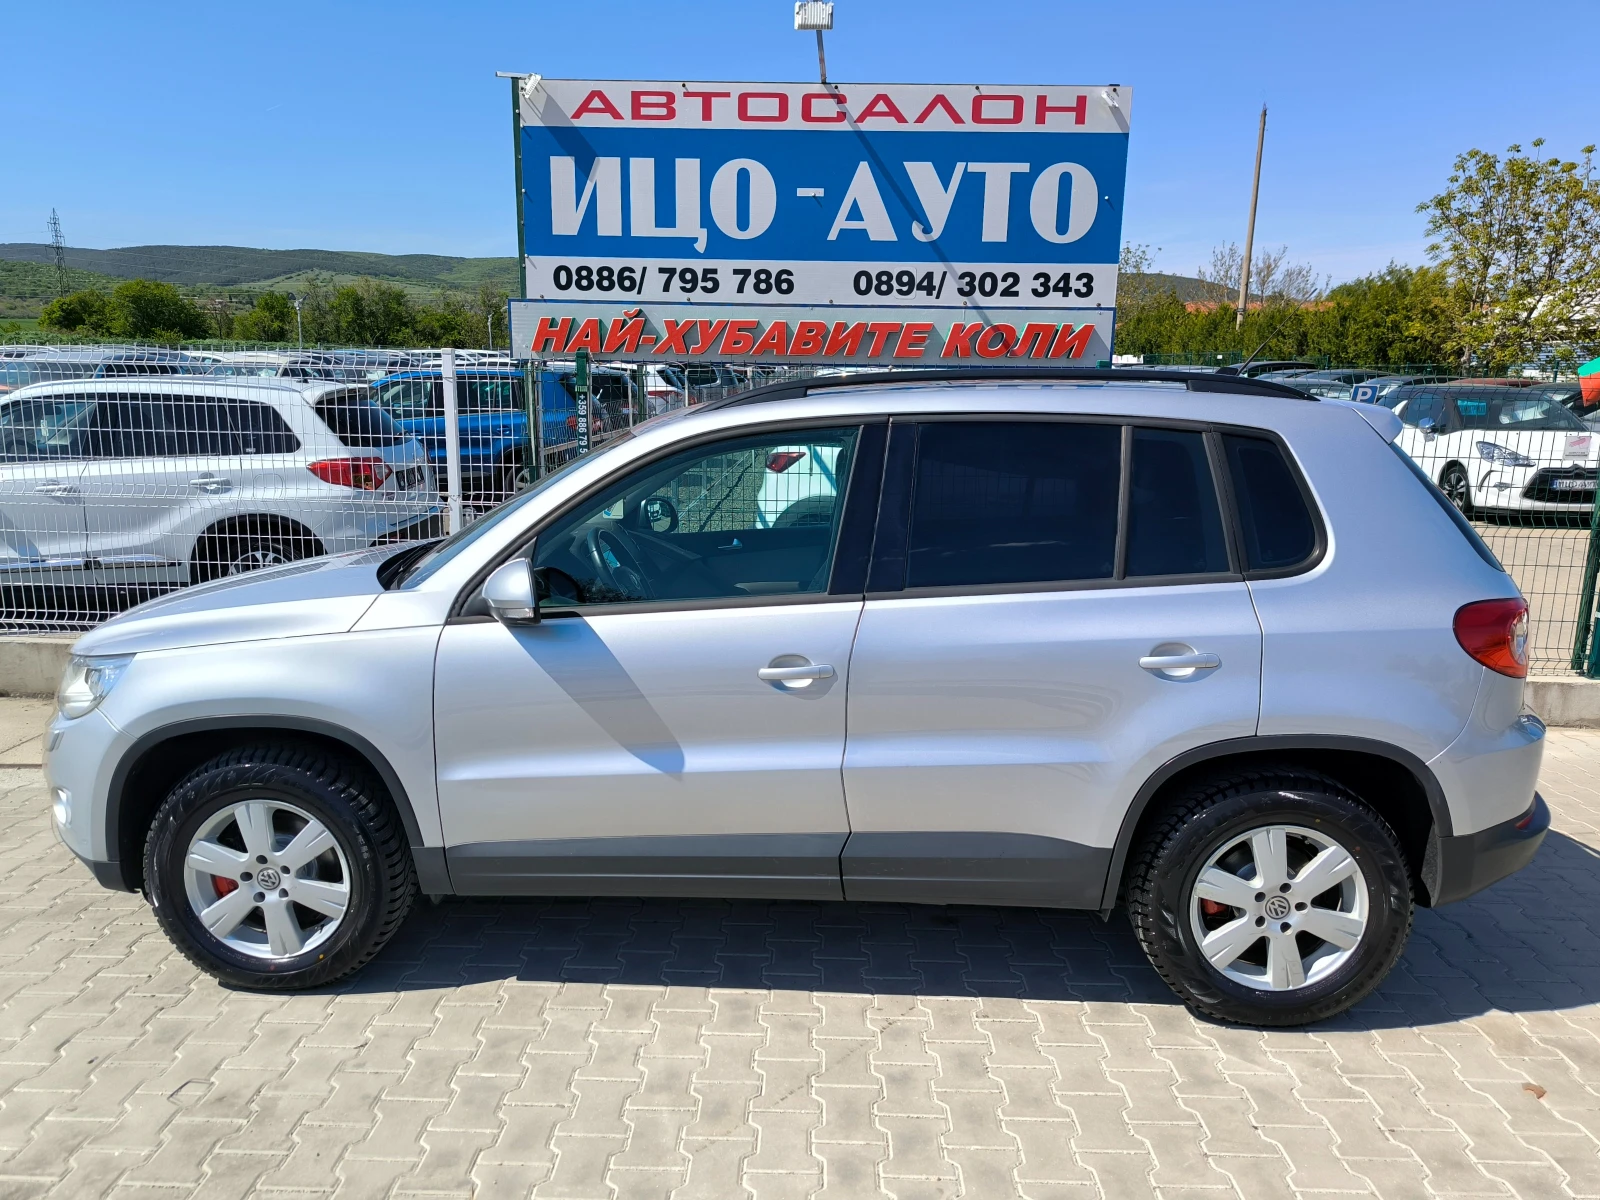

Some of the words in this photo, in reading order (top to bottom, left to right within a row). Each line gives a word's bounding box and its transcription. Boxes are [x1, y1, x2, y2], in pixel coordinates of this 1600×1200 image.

[570, 89, 1087, 125] АВТОСАЛОН
[553, 265, 647, 295] 0886/
[658, 267, 720, 293] 795
[732, 269, 795, 294] 786
[853, 270, 947, 299] 0894/
[957, 272, 1020, 297] 302
[1031, 272, 1094, 298] 343
[531, 308, 934, 358] НАЙ-ХУБАВИТЕ
[940, 322, 1095, 359] КОЛИ
[578, 394, 587, 415] +359
[1356, 387, 1372, 402] P
[578, 417, 587, 433] 886
[579, 435, 588, 446] 79
